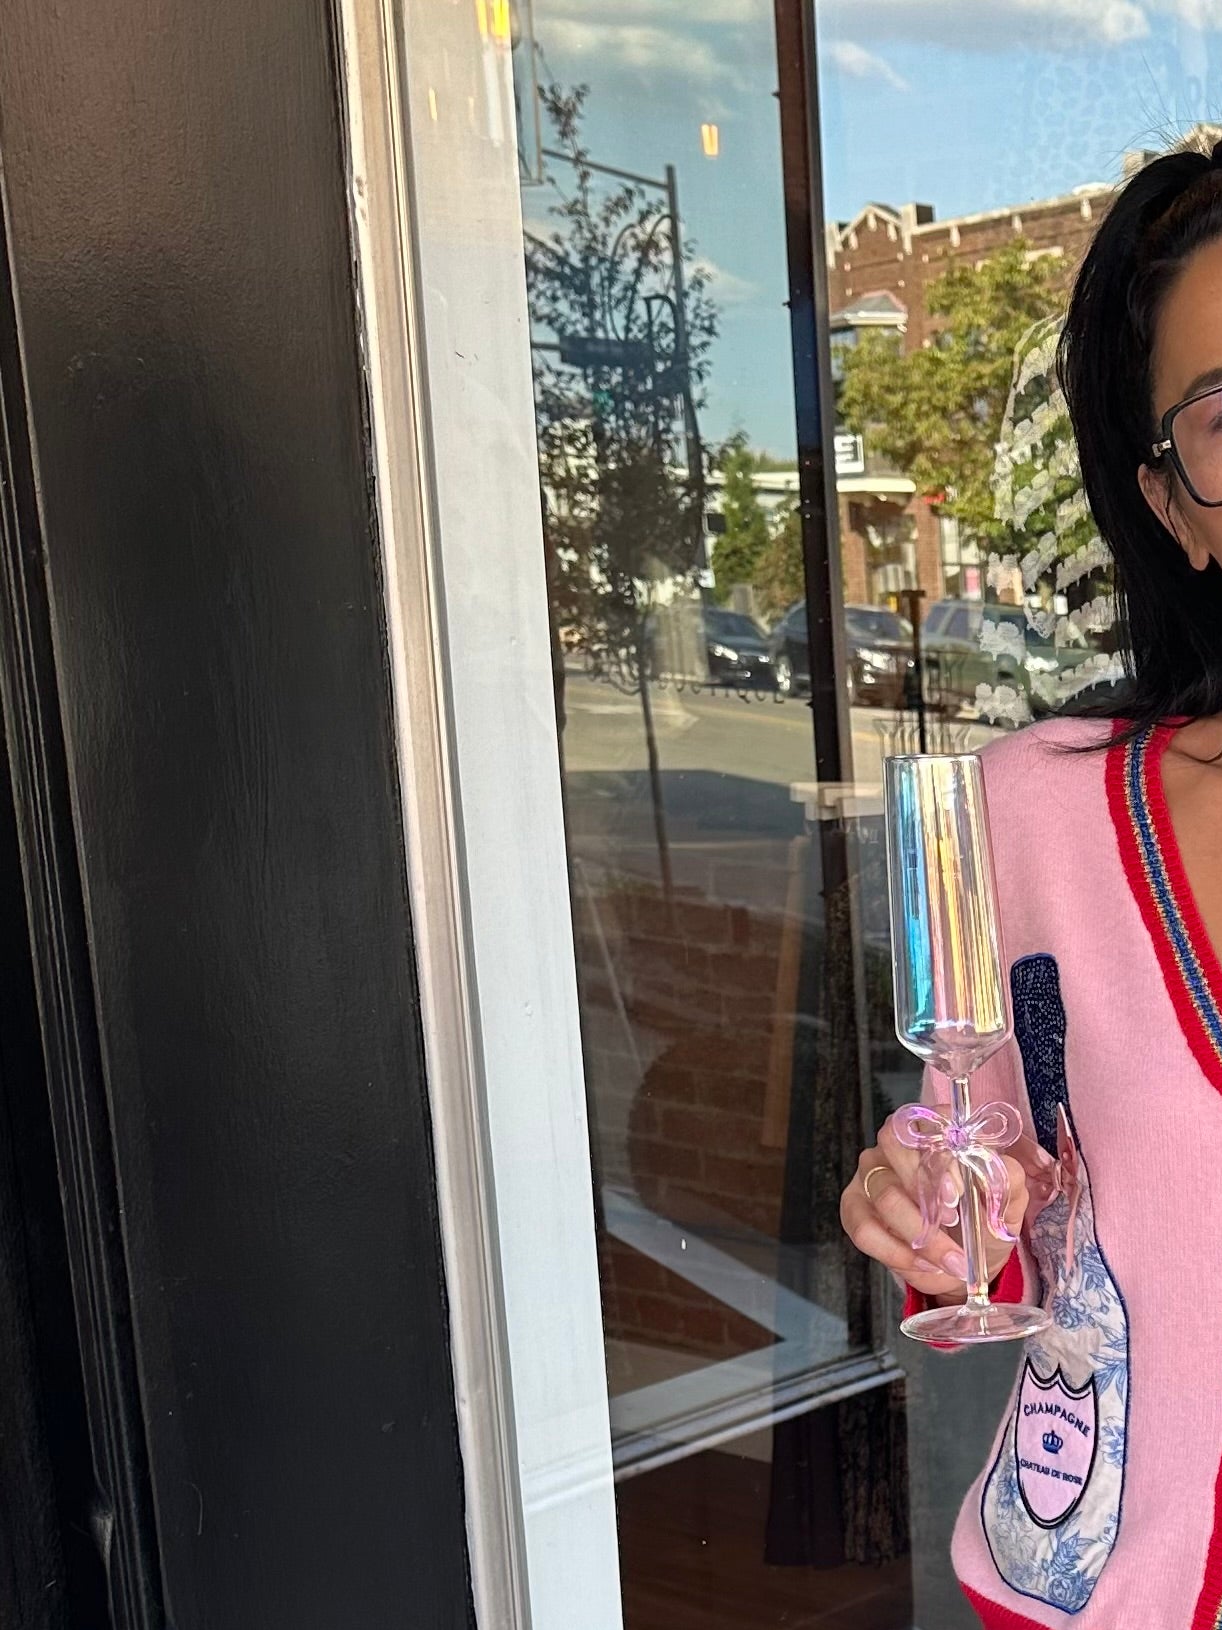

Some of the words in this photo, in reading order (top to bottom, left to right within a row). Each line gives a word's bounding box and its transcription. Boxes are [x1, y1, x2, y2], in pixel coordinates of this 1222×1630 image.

[1024, 1402, 1090, 1438] CHAMPAGNE
[1020, 1459, 1050, 1475] CHATEAU
[1051, 1468, 1061, 1479] DE
